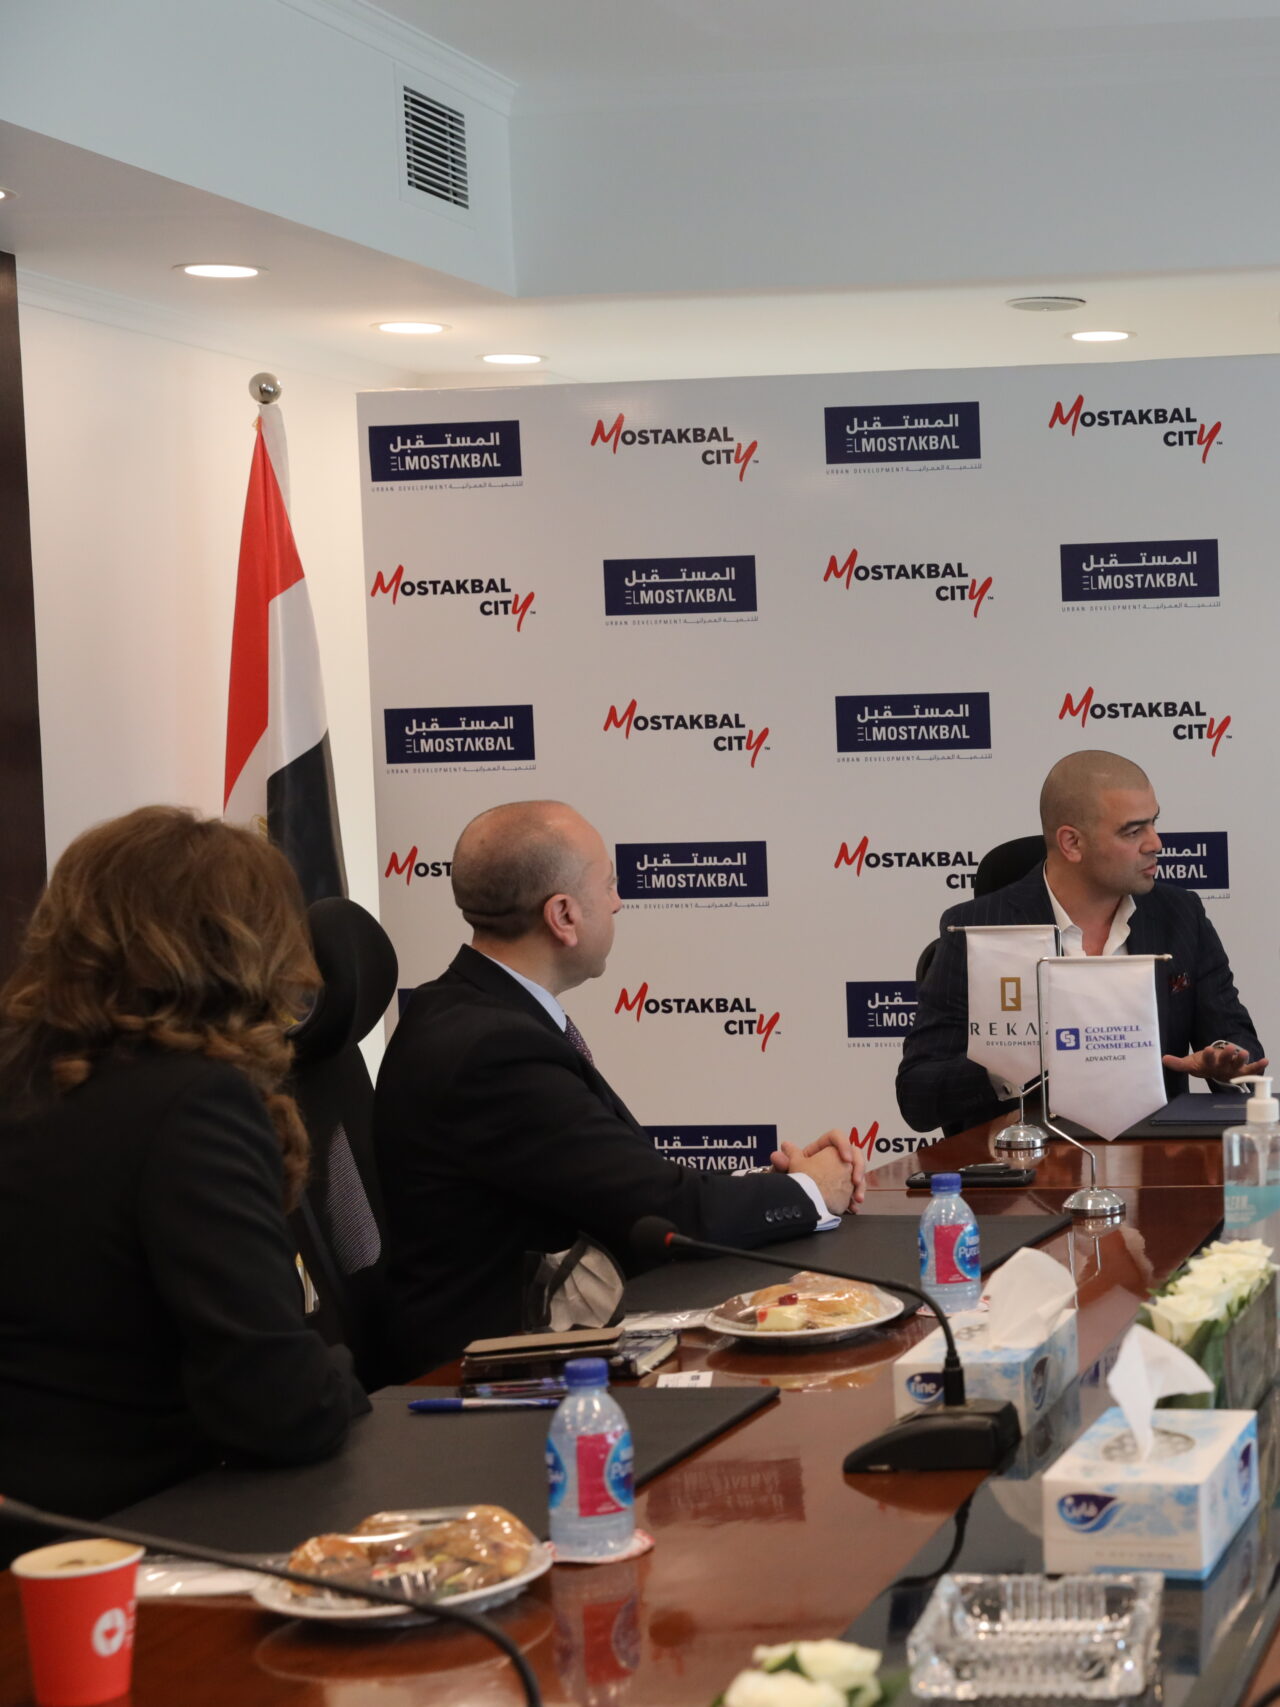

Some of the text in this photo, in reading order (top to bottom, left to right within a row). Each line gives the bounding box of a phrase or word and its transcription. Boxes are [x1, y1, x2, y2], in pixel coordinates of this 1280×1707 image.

[845, 413, 960, 434] المستقبل
[1049, 395, 1197, 434] MOSTAKBAL
[389, 431, 501, 453] المستقبل
[591, 413, 733, 453] MOSTAKBAL
[824, 549, 968, 589] MOSTAKBAL
[1081, 551, 1198, 573] المستقبل
[370, 564, 511, 604] MOSTAKBAL
[624, 567, 737, 588] المستقبل
[855, 703, 970, 724] المستقبل
[1059, 687, 1206, 727] MOSTAKBAL
[404, 717, 515, 736] المستقبل
[603, 698, 745, 738] MOSTAKBAL
[636, 852, 747, 872] المستقبل
[834, 835, 979, 878] MOSTAKBAL
[946, 873, 977, 889] CIT
[619, 902, 641, 910] RBAN
[614, 982, 756, 1021] MOSTAKBAL
[970, 1022, 1049, 1036] REKA
[1085, 1025, 1142, 1034] COLDWELL
[1085, 1034, 1126, 1043] BANKER
[1085, 1041, 1154, 1051] COMMERCIAL
